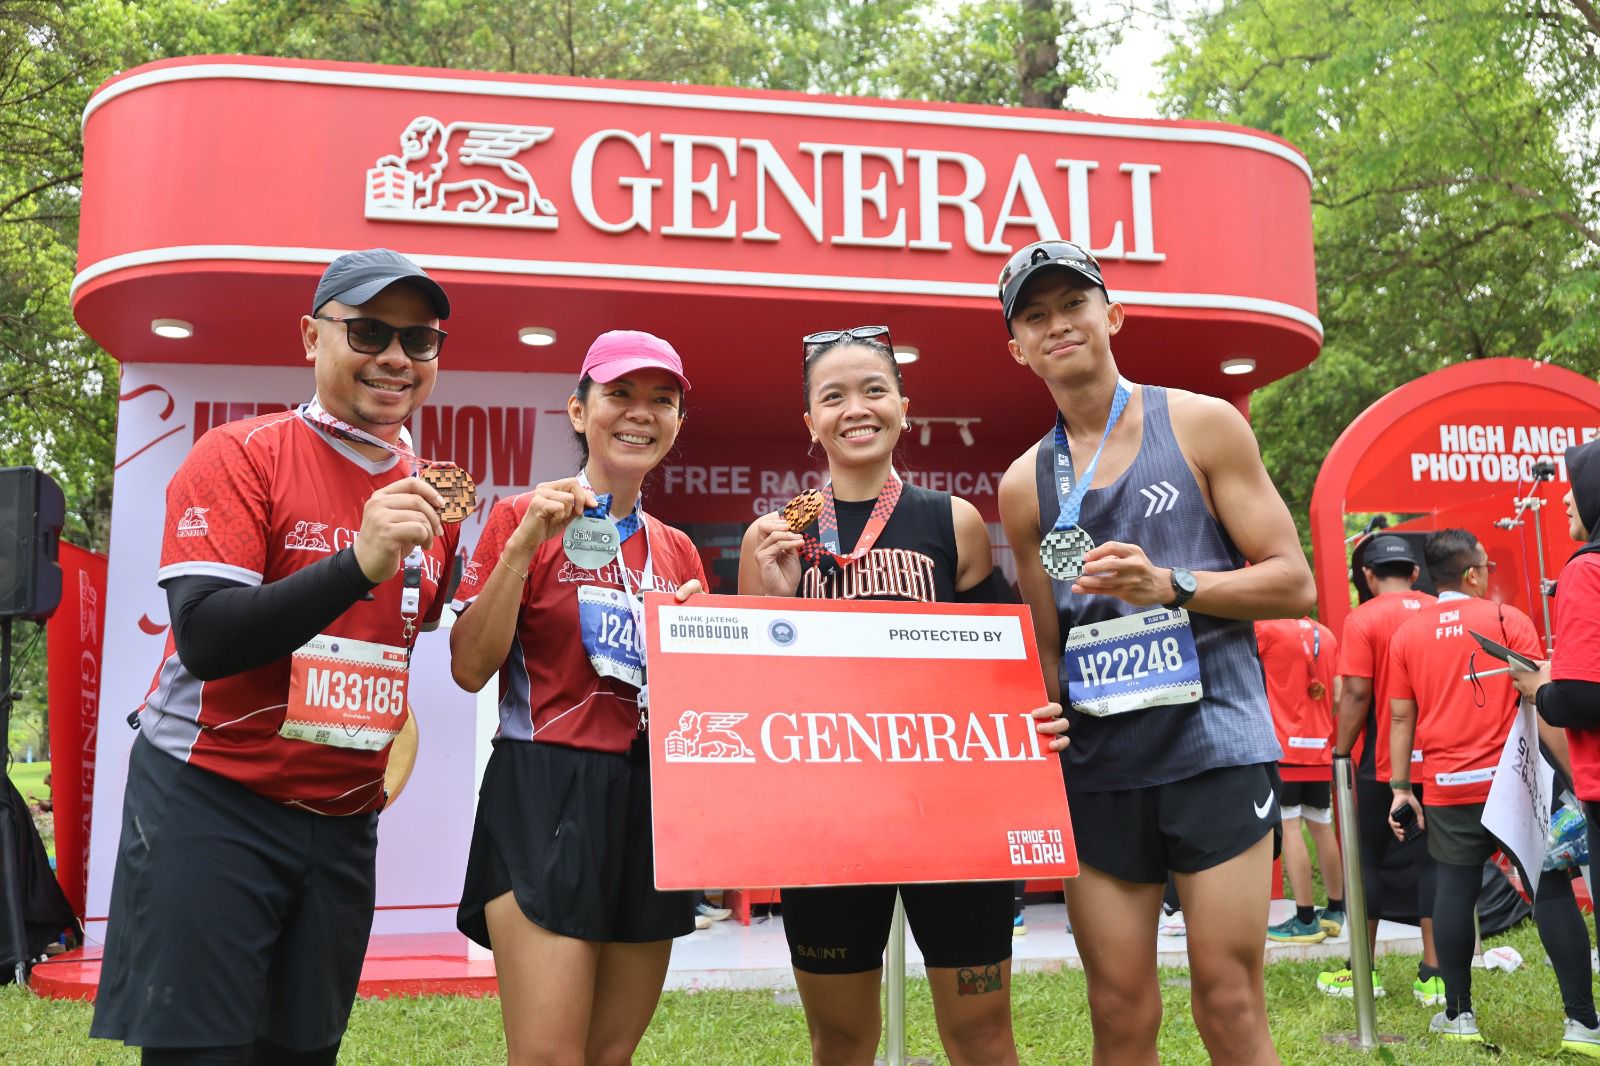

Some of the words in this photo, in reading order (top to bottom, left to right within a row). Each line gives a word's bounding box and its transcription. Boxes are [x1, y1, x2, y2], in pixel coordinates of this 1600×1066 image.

[570, 128, 1167, 263] GENERALI
[421, 405, 537, 487] NOW
[1439, 424, 1506, 454] HIGH
[664, 465, 753, 495] FREE
[1410, 453, 1571, 483] PHOTOBOT
[670, 624, 749, 640] BOROBUDUR
[678, 615, 703, 623] BANK
[706, 615, 739, 624] JATENG
[889, 629, 980, 642] PROTECTED
[983, 631, 1002, 642] BY
[1077, 636, 1184, 689] H22248
[305, 667, 405, 717] M33185
[760, 711, 1048, 763] GENERALI
[1007, 829, 1046, 844] STRIDE
[1047, 829, 1063, 843] TO
[1009, 843, 1066, 865] GLORY
[797, 944, 849, 960] SAINT
